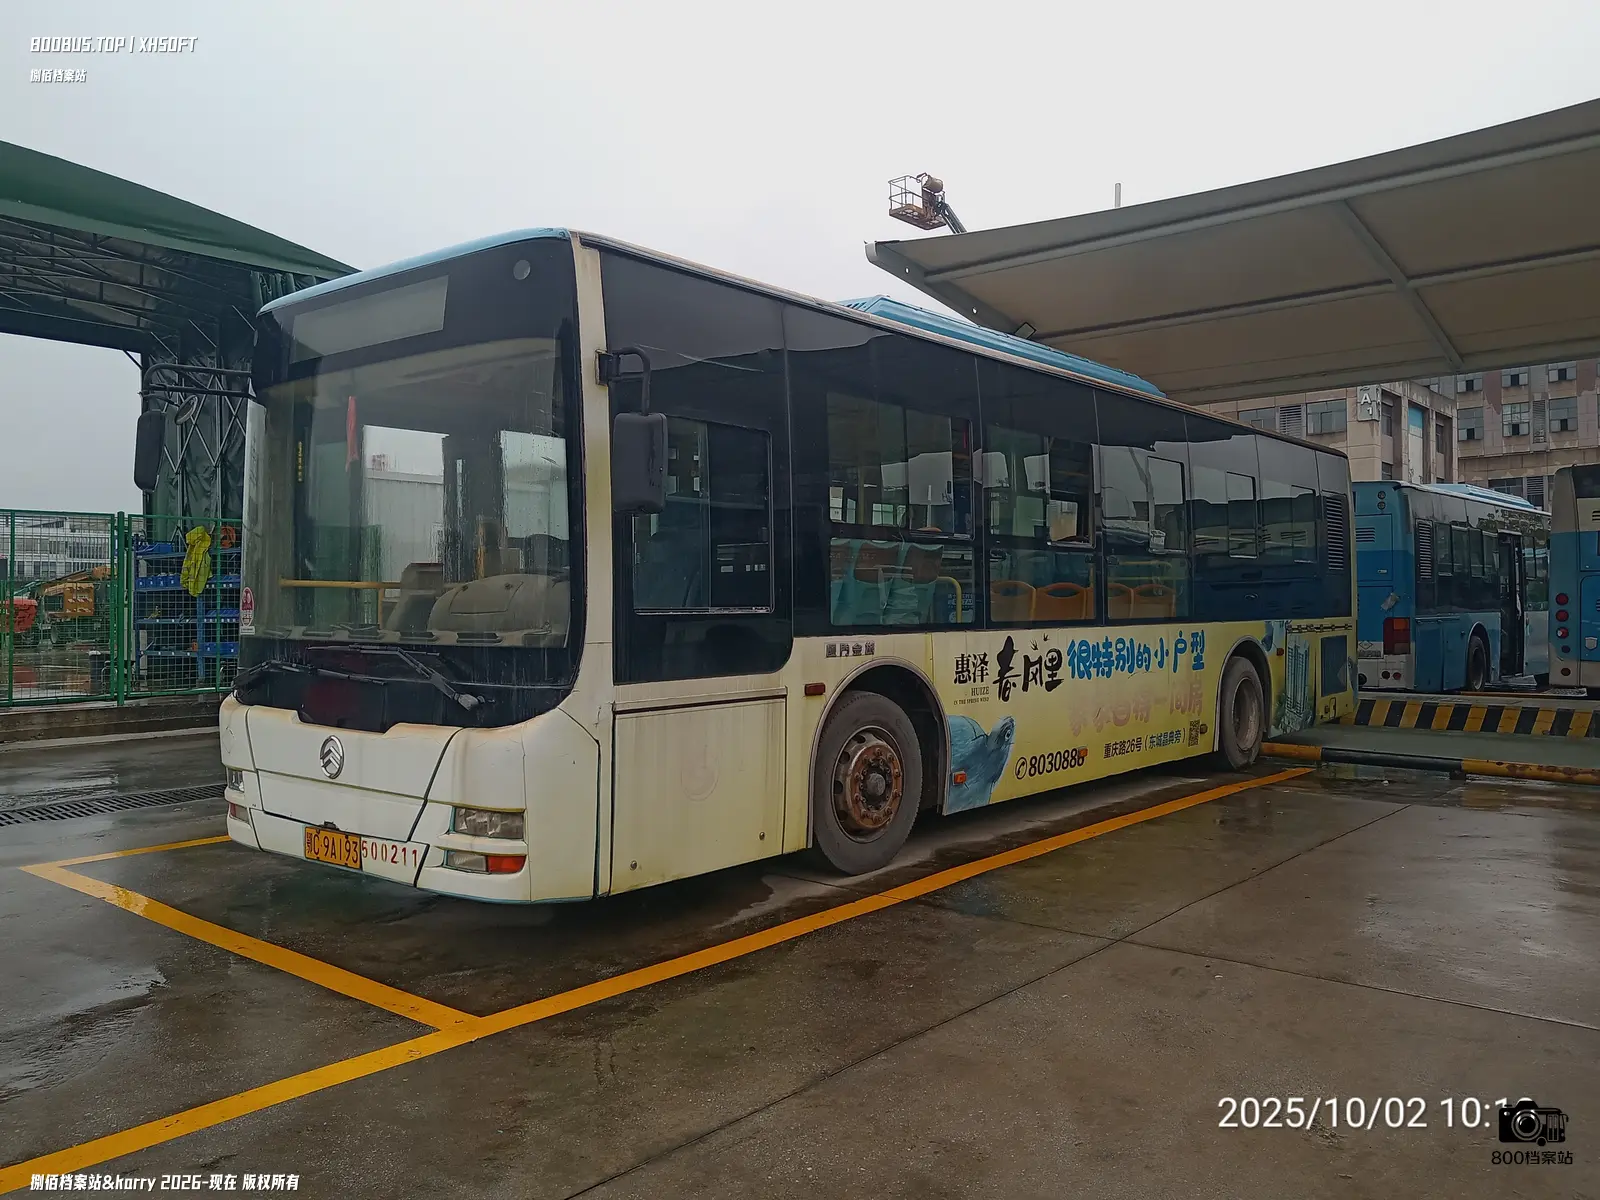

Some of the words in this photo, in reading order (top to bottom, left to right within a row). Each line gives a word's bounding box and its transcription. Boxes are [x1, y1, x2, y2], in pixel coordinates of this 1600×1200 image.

[1360, 392, 1371, 405] A
[953, 652, 989, 685] 惠泽
[1067, 629, 1205, 680] 很特别的小户型
[361, 841, 418, 868] 500211
